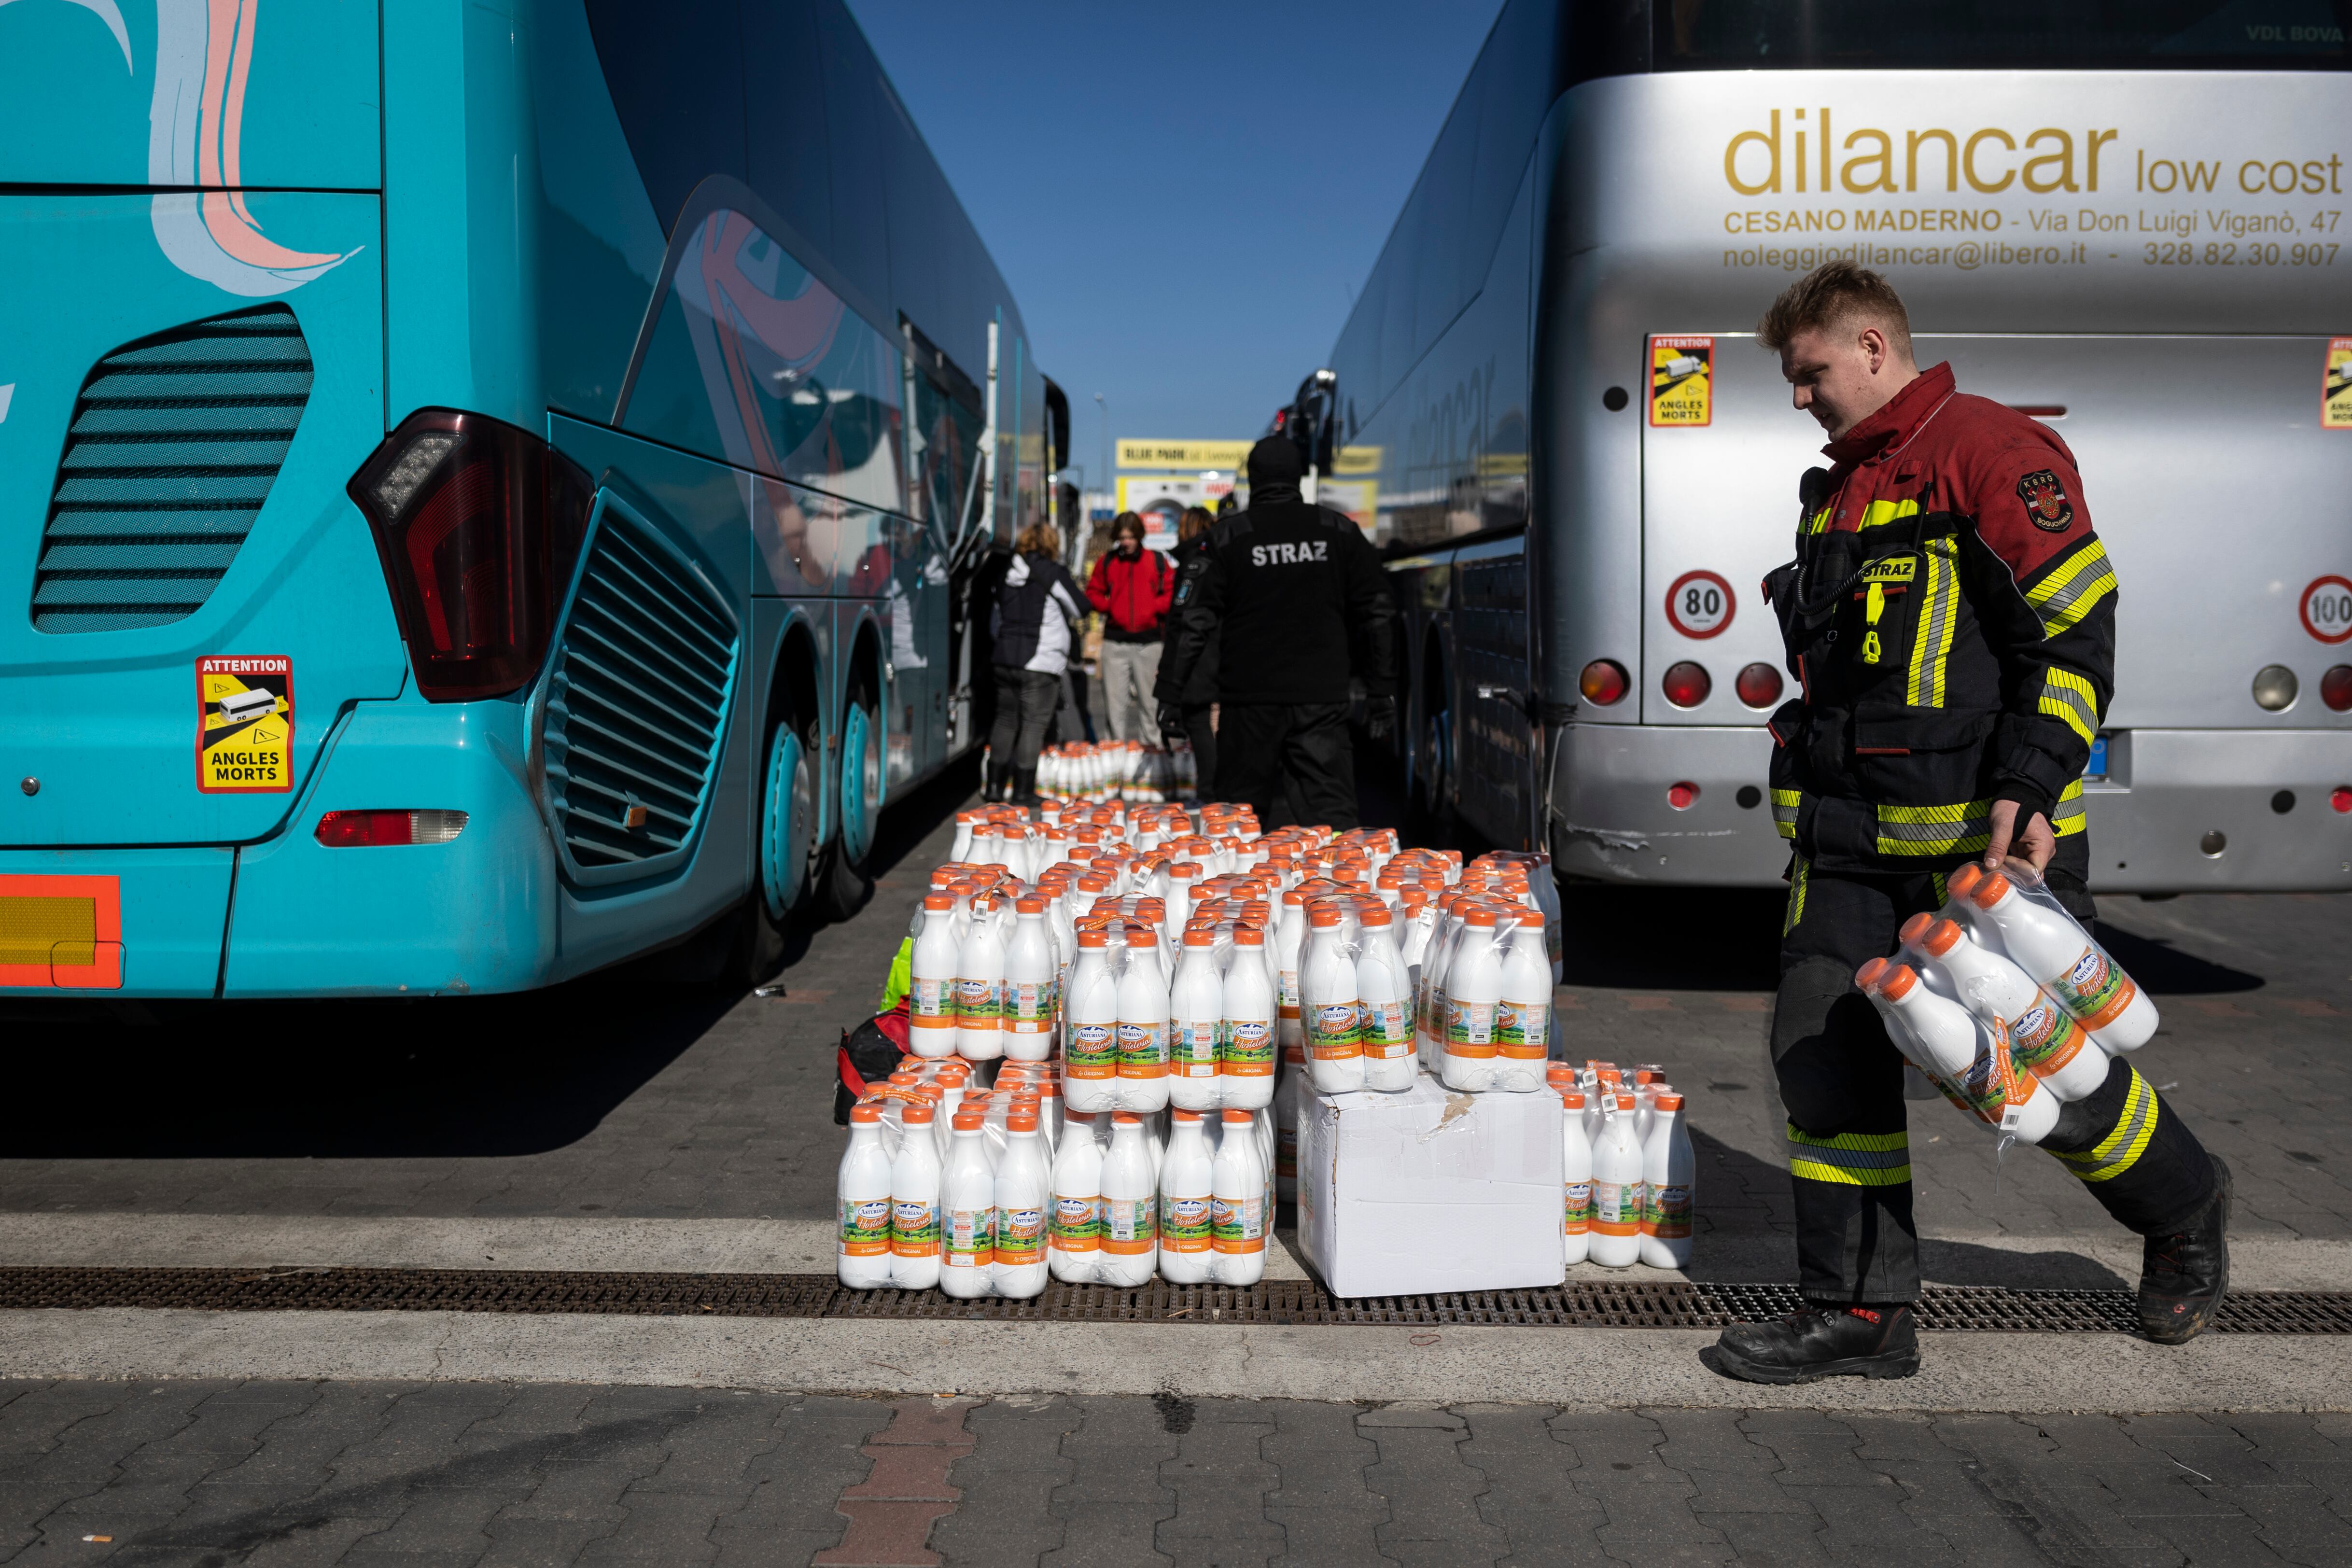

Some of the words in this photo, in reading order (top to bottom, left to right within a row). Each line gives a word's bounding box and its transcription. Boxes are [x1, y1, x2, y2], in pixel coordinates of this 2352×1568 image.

[2246, 26, 2285, 42] VDL
[2291, 26, 2344, 42] BOVA
[1723, 108, 2118, 196] dilancar
[2136, 149, 2222, 194] low
[2238, 152, 2343, 195] cost
[1723, 210, 1847, 235] CESANO
[1854, 209, 2002, 233] MADERNO
[2028, 210, 2069, 233] Via
[2077, 210, 2130, 234] Don
[2137, 210, 2198, 239] Luigi
[2205, 210, 2302, 239] Viganò,
[2310, 211, 2341, 234] 47
[1723, 241, 2087, 271] noleggiodilancar@libero.it
[2142, 243, 2339, 267] 328.82.30.907
[1654, 338, 1711, 348] ATTENTION
[1660, 401, 1703, 409] ANGLES
[2023, 475, 2053, 488] KSRG
[2037, 512, 2072, 527] BOGUCHWAŁA
[1685, 588, 1720, 616] 80
[2312, 595, 2352, 624] 100
[203, 659, 287, 672] ATTENTION
[211, 752, 280, 766] ANGLES
[216, 768, 277, 781] MORTS
[2074, 957, 2098, 983] ASTURIANA
[2113, 991, 2131, 1011] ORIGINAL
[2016, 1012, 2044, 1036] ASTURIANA
[2055, 1045, 2076, 1065] ORIGINAL
[1967, 1059, 1996, 1083] ASTURIANA
